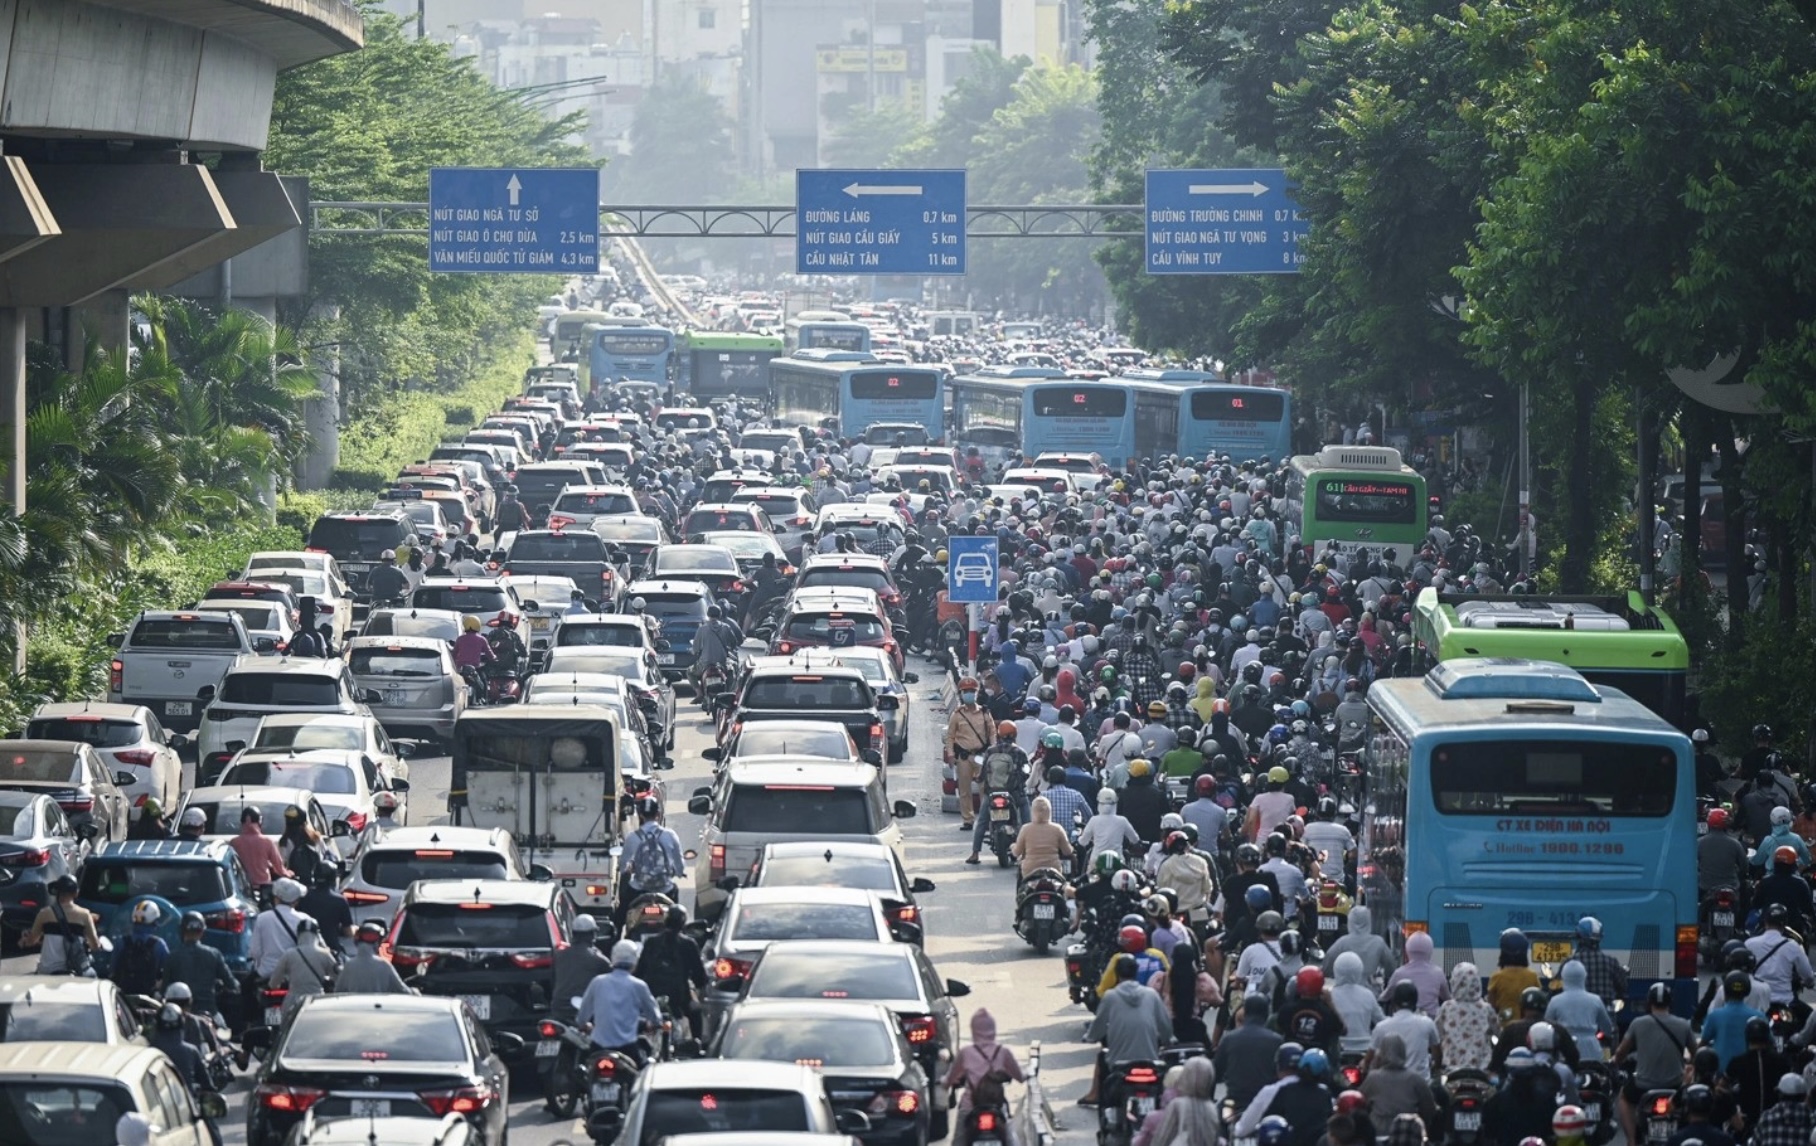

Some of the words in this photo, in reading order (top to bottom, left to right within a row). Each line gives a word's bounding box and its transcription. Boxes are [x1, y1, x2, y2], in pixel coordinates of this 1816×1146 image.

[434, 205, 454, 221] NÚT
[457, 208, 480, 222] GIAO
[484, 207, 504, 222] NGÃ
[805, 208, 840, 223] ĐƯỜNG
[844, 208, 870, 223] LÁNG
[942, 211, 957, 223] km
[1152, 206, 1186, 222] ĐƯỜNG
[1190, 206, 1230, 222] TRƯỜNG
[1233, 210, 1264, 222] CHINH
[434, 227, 454, 242] NÚT
[457, 230, 480, 242] GIAO
[483, 228, 490, 242] Ô
[494, 230, 514, 245] CHỢ
[579, 232, 594, 243] km
[806, 228, 825, 244] NÚT
[828, 232, 851, 244] GIAO
[878, 228, 900, 244] GIẤY
[932, 232, 938, 244] 5
[942, 232, 957, 244] km
[1152, 228, 1172, 244] NÚT
[1174, 232, 1197, 244] GIAO
[1200, 229, 1220, 243] NGÃ
[1240, 231, 1267, 246] VỌNG
[1283, 231, 1289, 243] 3
[457, 248, 480, 263] MIẾU
[483, 248, 510, 264] QUỐC
[528, 249, 554, 263] GIÁM
[579, 253, 594, 264] km
[829, 252, 855, 266] NHẬT
[860, 252, 879, 265] TÂN
[928, 254, 938, 265] 11
[942, 253, 957, 265] km
[1203, 252, 1222, 265] TUY
[1283, 252, 1289, 264] 8
[888, 378, 900, 387] 02
[1073, 394, 1086, 404] 02
[1232, 398, 1244, 407] 01
[1326, 482, 1338, 492] 61
[834, 630, 849, 644] G7
[1496, 820, 1512, 831] CT
[1516, 820, 1531, 831] XE
[1507, 911, 1534, 925] 29B
[1299, 1017, 1317, 1030] 12
